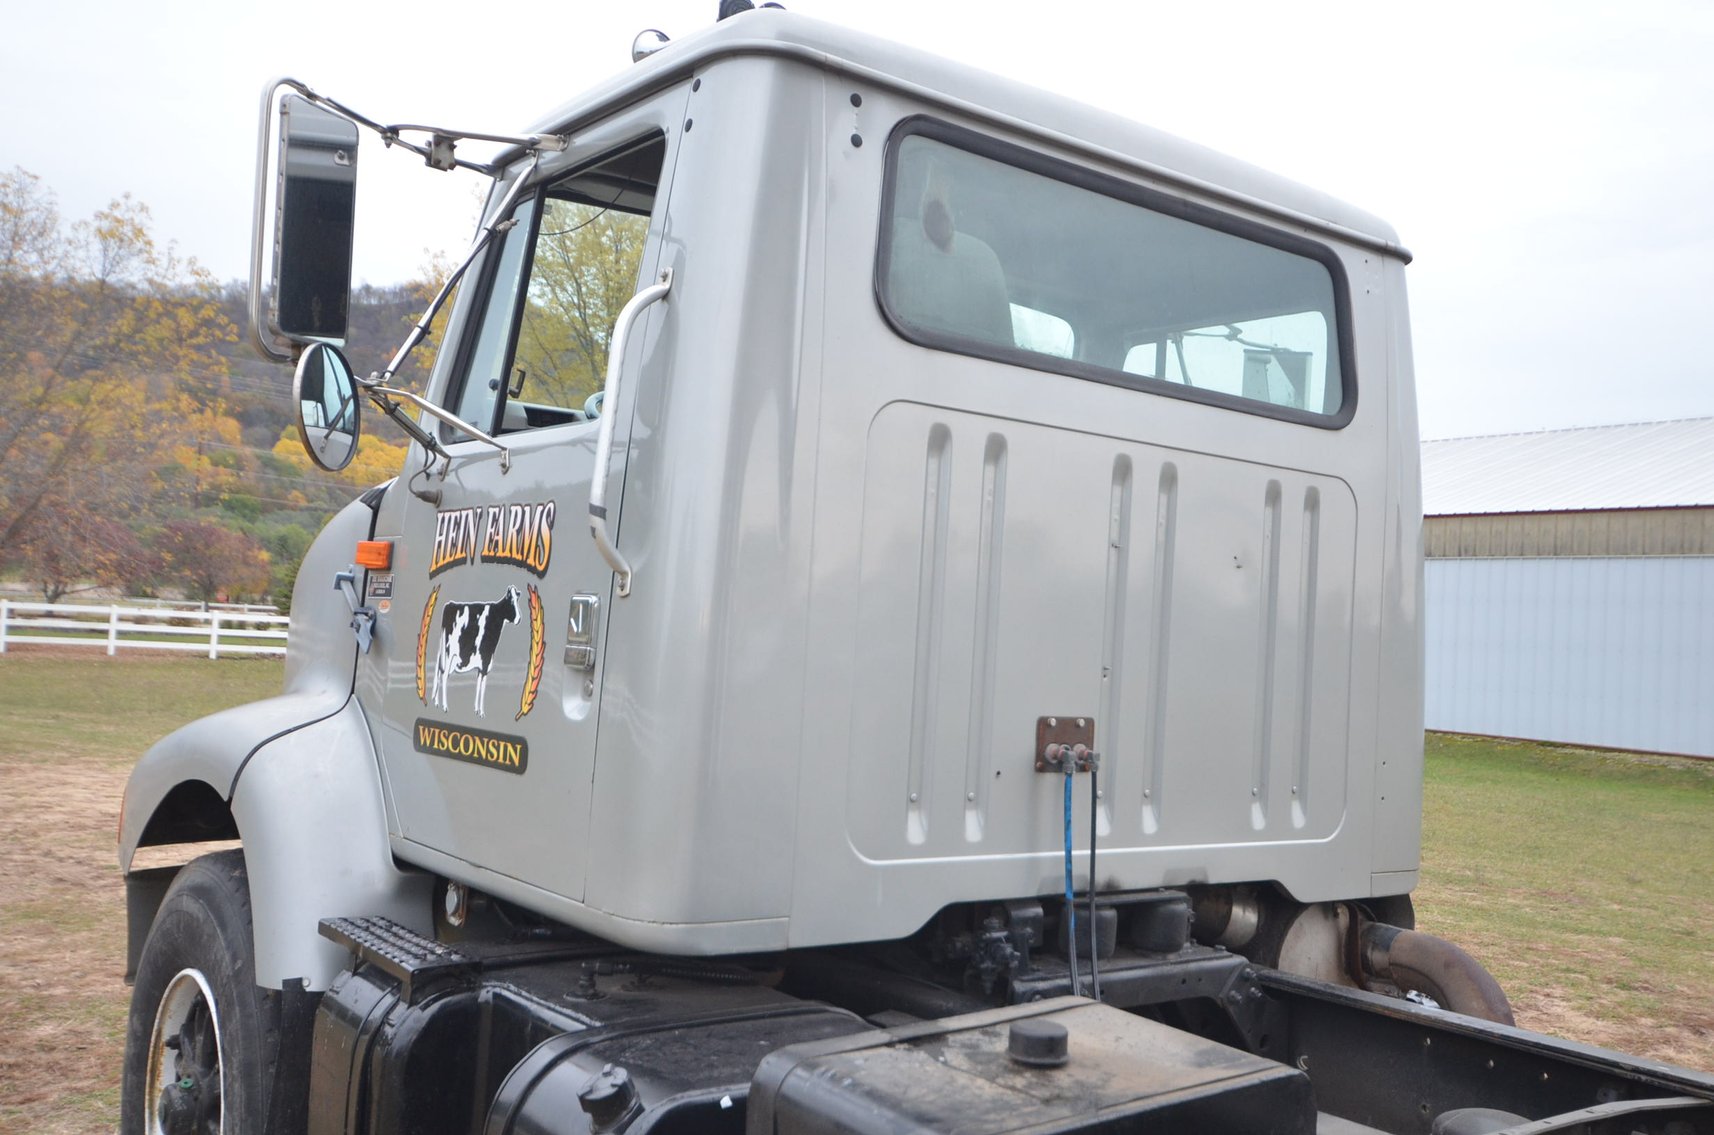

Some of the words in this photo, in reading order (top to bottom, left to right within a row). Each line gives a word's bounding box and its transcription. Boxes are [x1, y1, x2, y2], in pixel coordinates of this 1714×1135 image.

[429, 507, 482, 577] HEIN
[481, 502, 555, 578] FARMS
[418, 726, 521, 766] WISCONSIN
